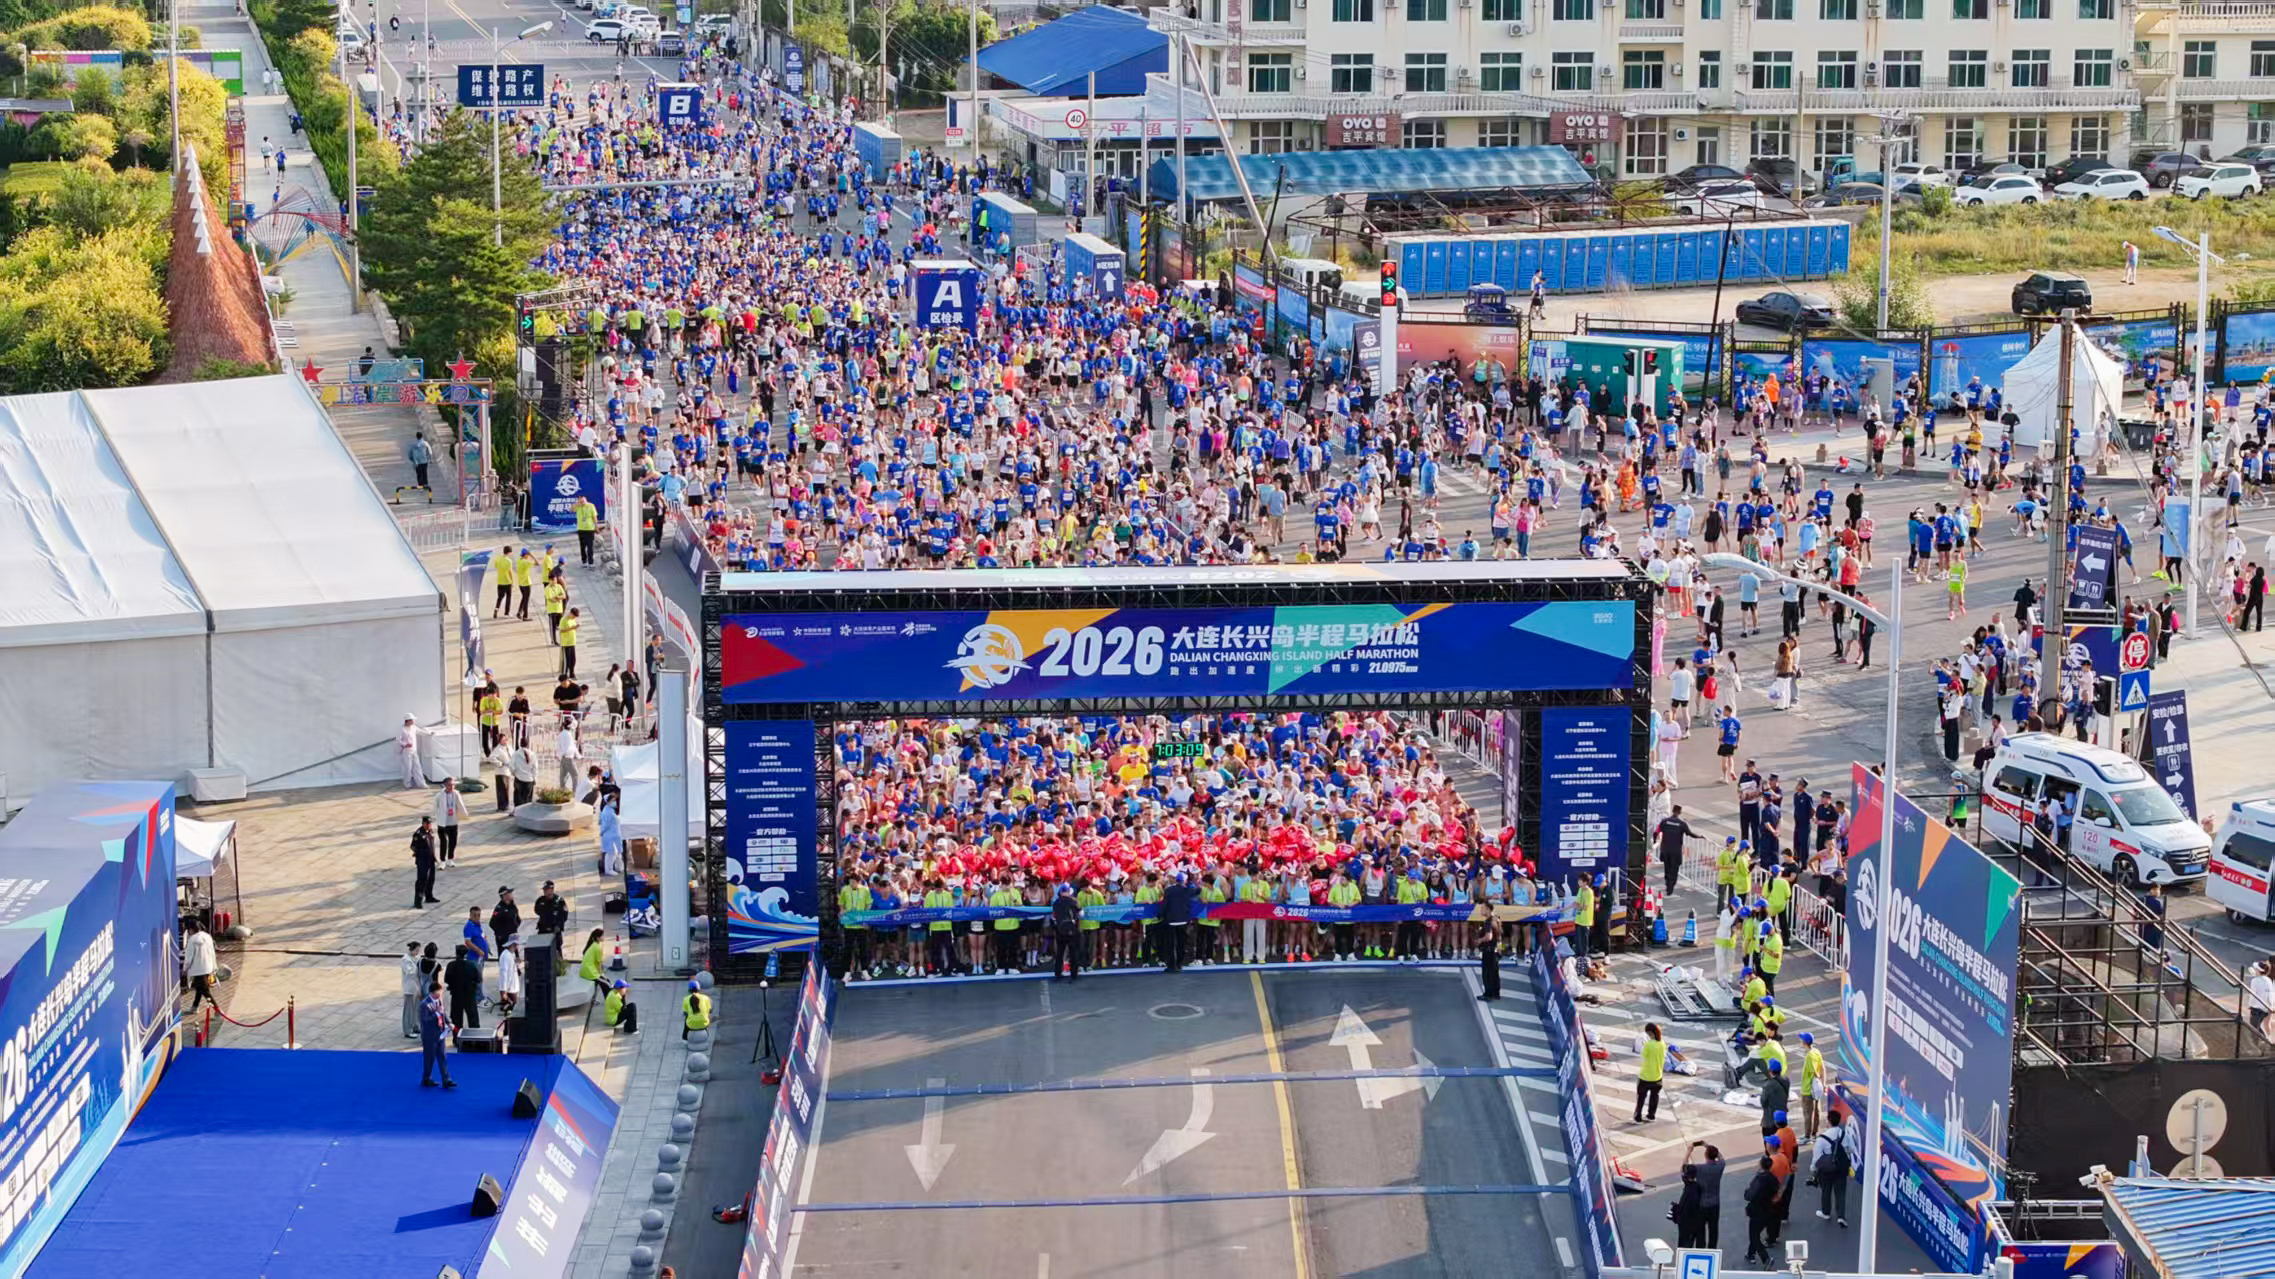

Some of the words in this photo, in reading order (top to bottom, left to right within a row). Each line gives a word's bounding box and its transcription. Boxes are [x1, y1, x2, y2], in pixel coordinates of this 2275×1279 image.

[472, 69, 534, 82] 保护路产
[471, 84, 535, 97] 维护路权
[669, 95, 692, 114] B
[1070, 115, 1082, 123] 40
[1342, 117, 1372, 130] OYO
[1565, 115, 1595, 127] OYO
[1078, 122, 1194, 136] 平超市
[1565, 128, 1609, 140] 吉平宾馆
[1342, 130, 1386, 143] 吉平宾馆
[931, 280, 962, 308] A
[1170, 622, 1420, 650] 大连长兴岛半程马拉松
[1039, 625, 1165, 678] 2026
[1169, 652, 1211, 663] DALIAN
[1213, 651, 1279, 662] CHANGXING
[1282, 650, 1323, 661] ISLAND
[1325, 649, 1354, 660] HALF
[1356, 648, 1419, 659] MARATHON
[2127, 639, 2146, 665] 停
[1155, 743, 1204, 757] 7:03:09
[2083, 831, 2099, 843] 120
[1287, 907, 1309, 917] 2026
[1889, 887, 1922, 960] 026
[2, 1025, 28, 1123] 26
[1880, 1154, 1898, 1205] 26
